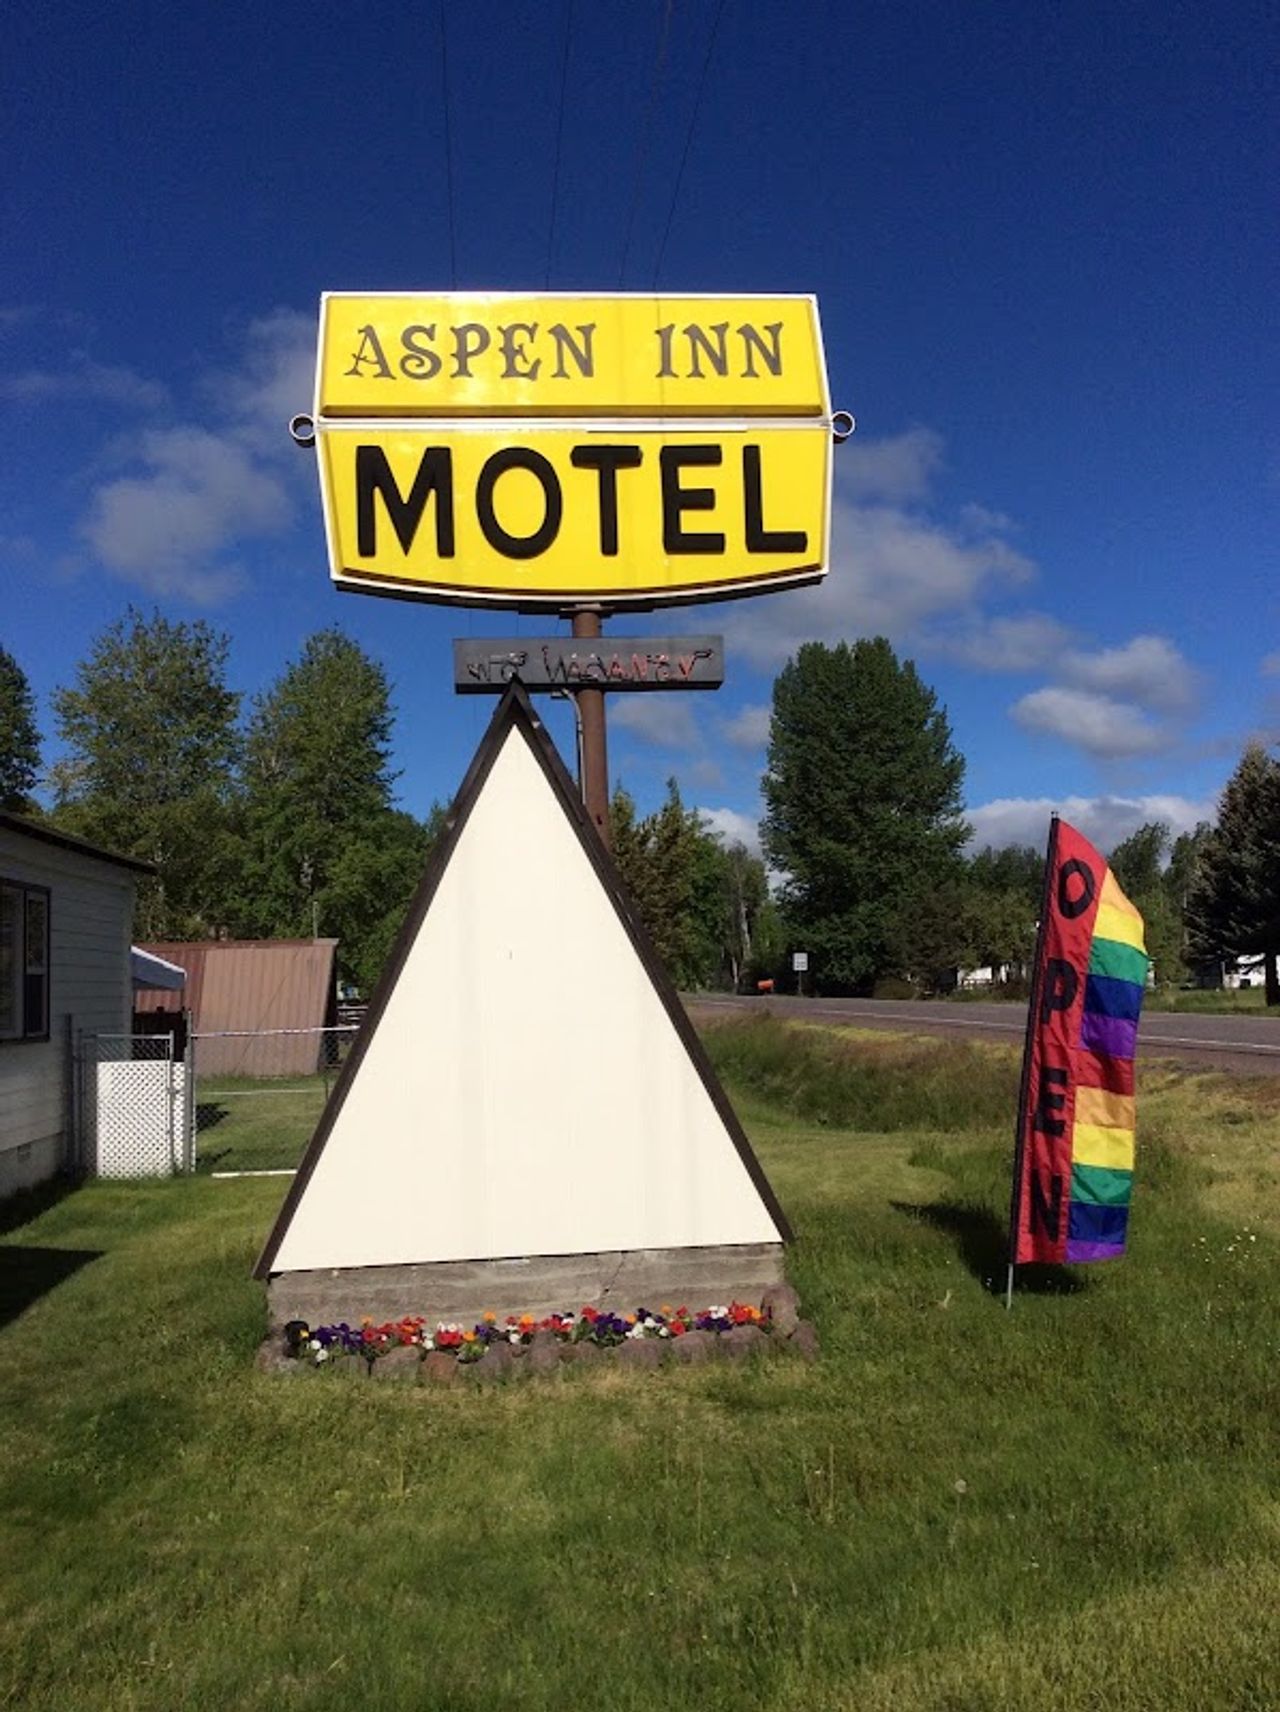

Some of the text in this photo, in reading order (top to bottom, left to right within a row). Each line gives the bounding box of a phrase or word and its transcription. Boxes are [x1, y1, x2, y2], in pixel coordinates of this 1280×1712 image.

[344, 322, 783, 381] ASPEN INN
[356, 445, 808, 560] MOTEL
[1029, 857, 1095, 1244] OPEN
